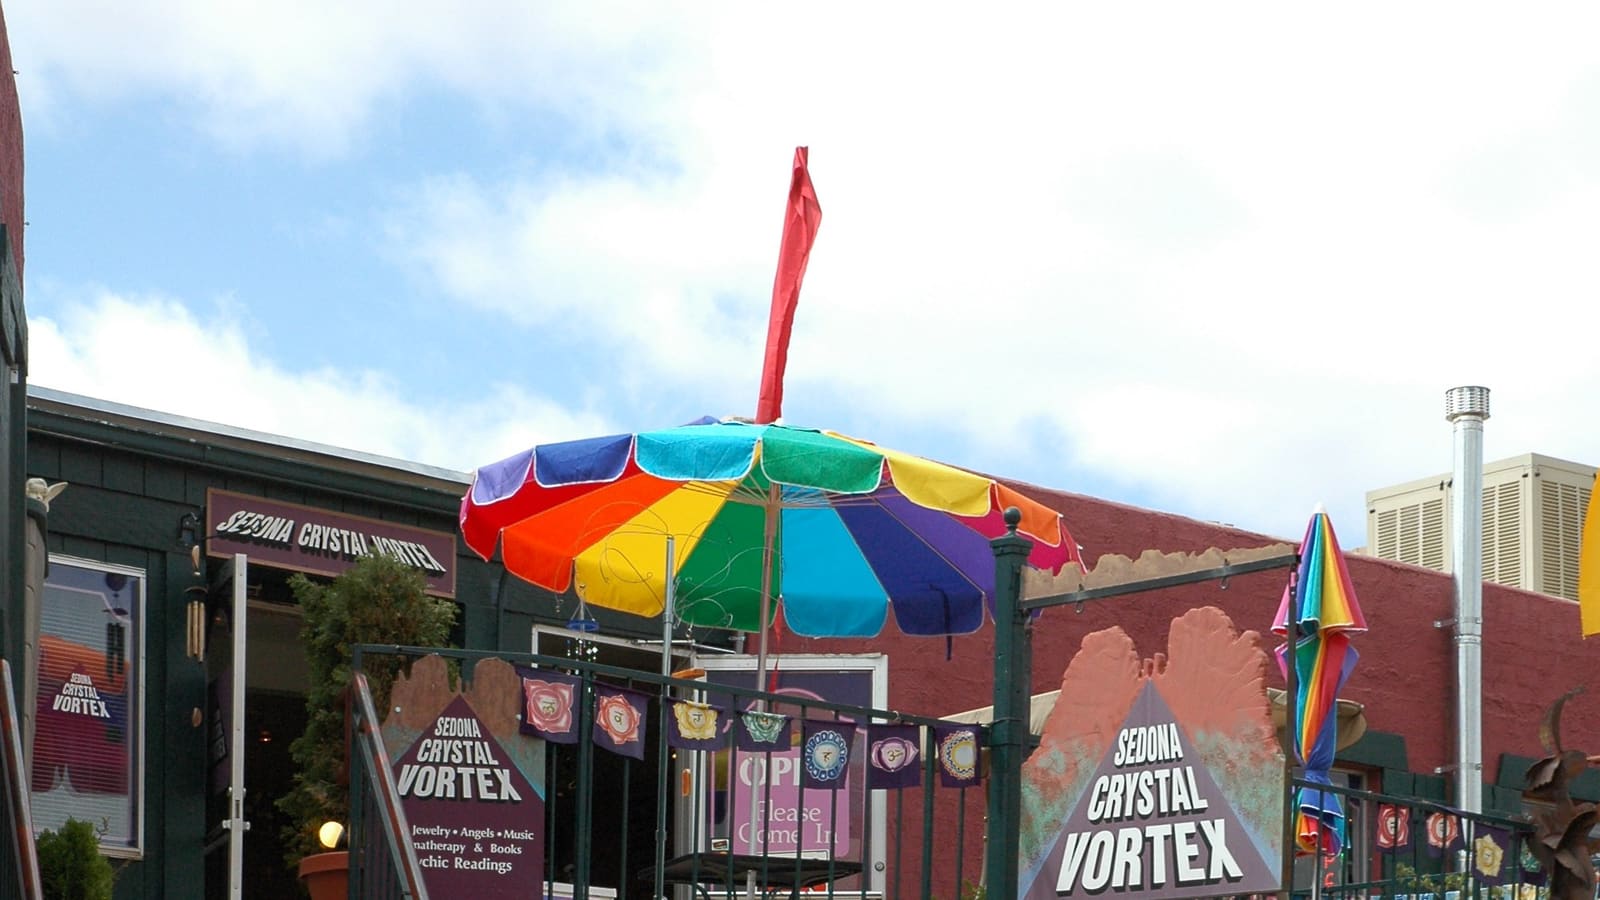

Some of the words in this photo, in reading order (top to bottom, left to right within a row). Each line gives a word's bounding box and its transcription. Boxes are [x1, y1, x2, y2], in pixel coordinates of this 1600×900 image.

[216, 510, 295, 543] SEDONA
[298, 522, 374, 558] CRYSTAL
[62, 682, 100, 700] CRYSTAL
[70, 672, 93, 686] SEDONA
[52, 694, 111, 719] VORTEX
[434, 716, 482, 739] SEDONA
[416, 738, 499, 766] CRYSTAL
[1114, 722, 1184, 767] SEDONA
[397, 764, 522, 802] VORTEX
[1087, 766, 1208, 822] CRYSTAL
[412, 824, 451, 839] Jewelry
[460, 827, 495, 840] Angels
[503, 829, 535, 841] Music
[815, 822, 839, 844] In
[473, 843, 483, 853] &
[490, 843, 522, 855] Books
[1055, 818, 1244, 894] VORTEX
[454, 856, 513, 874] Readings
